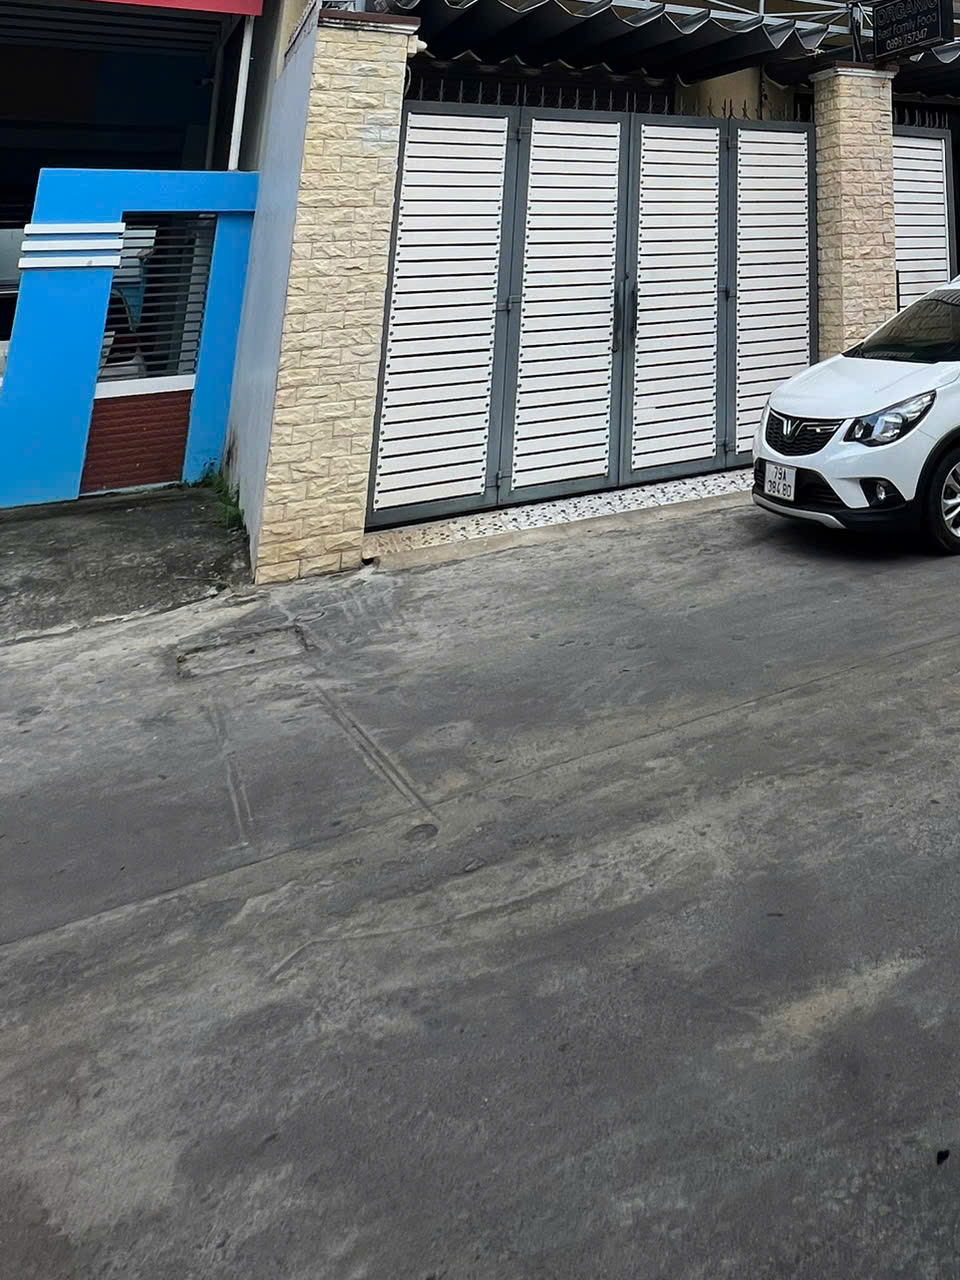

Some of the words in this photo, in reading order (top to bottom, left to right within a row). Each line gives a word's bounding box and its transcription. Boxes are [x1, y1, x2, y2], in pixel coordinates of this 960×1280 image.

[878, 27, 892, 40] Best
[893, 20, 916, 34] Family
[917, 13, 937, 27] Food
[774, 466, 787, 481] 79A
